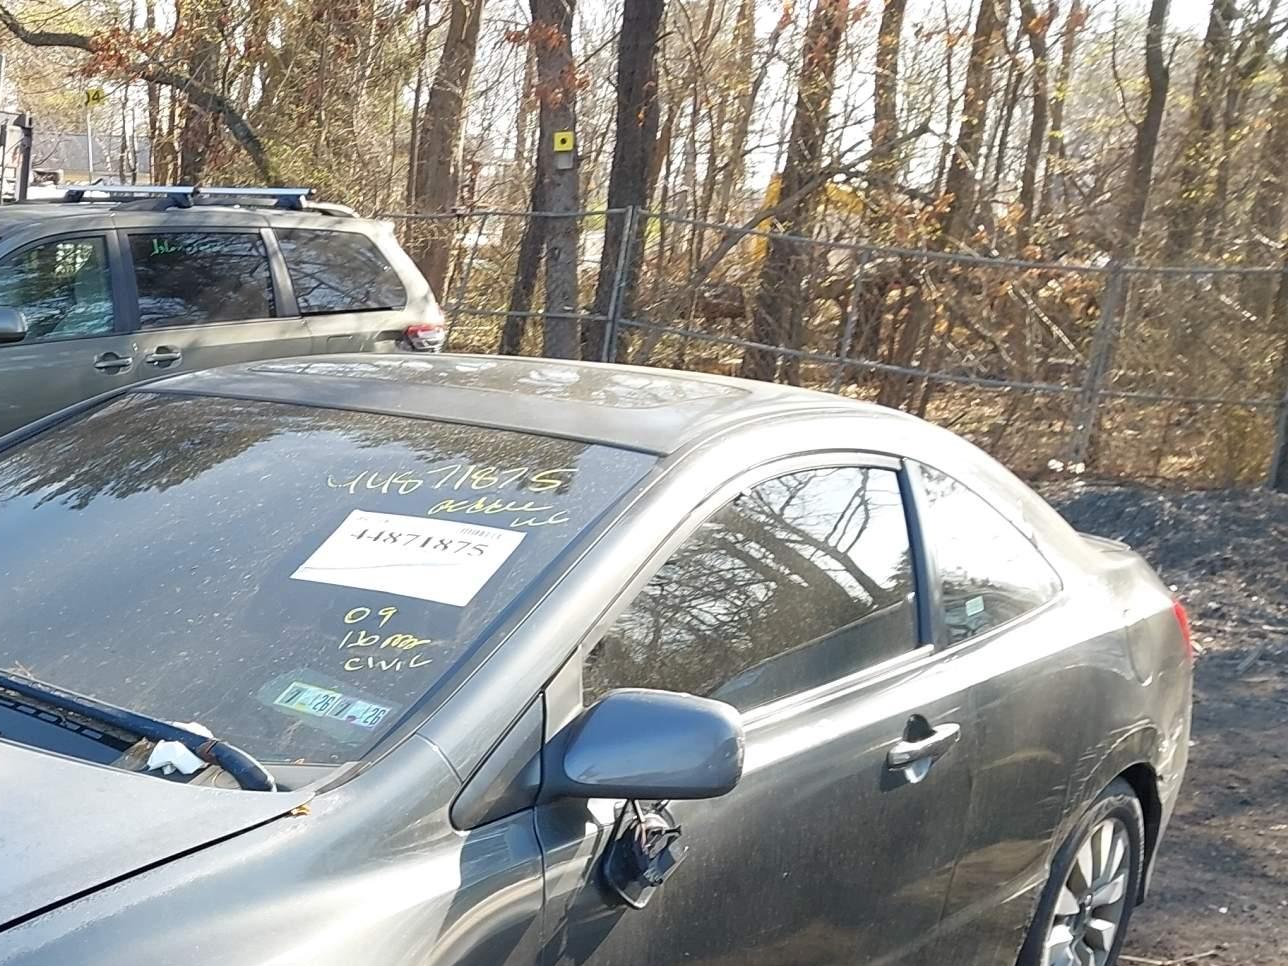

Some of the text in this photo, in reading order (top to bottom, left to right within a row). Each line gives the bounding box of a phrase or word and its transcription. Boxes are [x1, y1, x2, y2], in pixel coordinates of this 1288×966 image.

[327, 464, 580, 494] 44871875
[350, 528, 489, 557] 44871875
[343, 606, 398, 629] 09
[312, 693, 336, 713] 26
